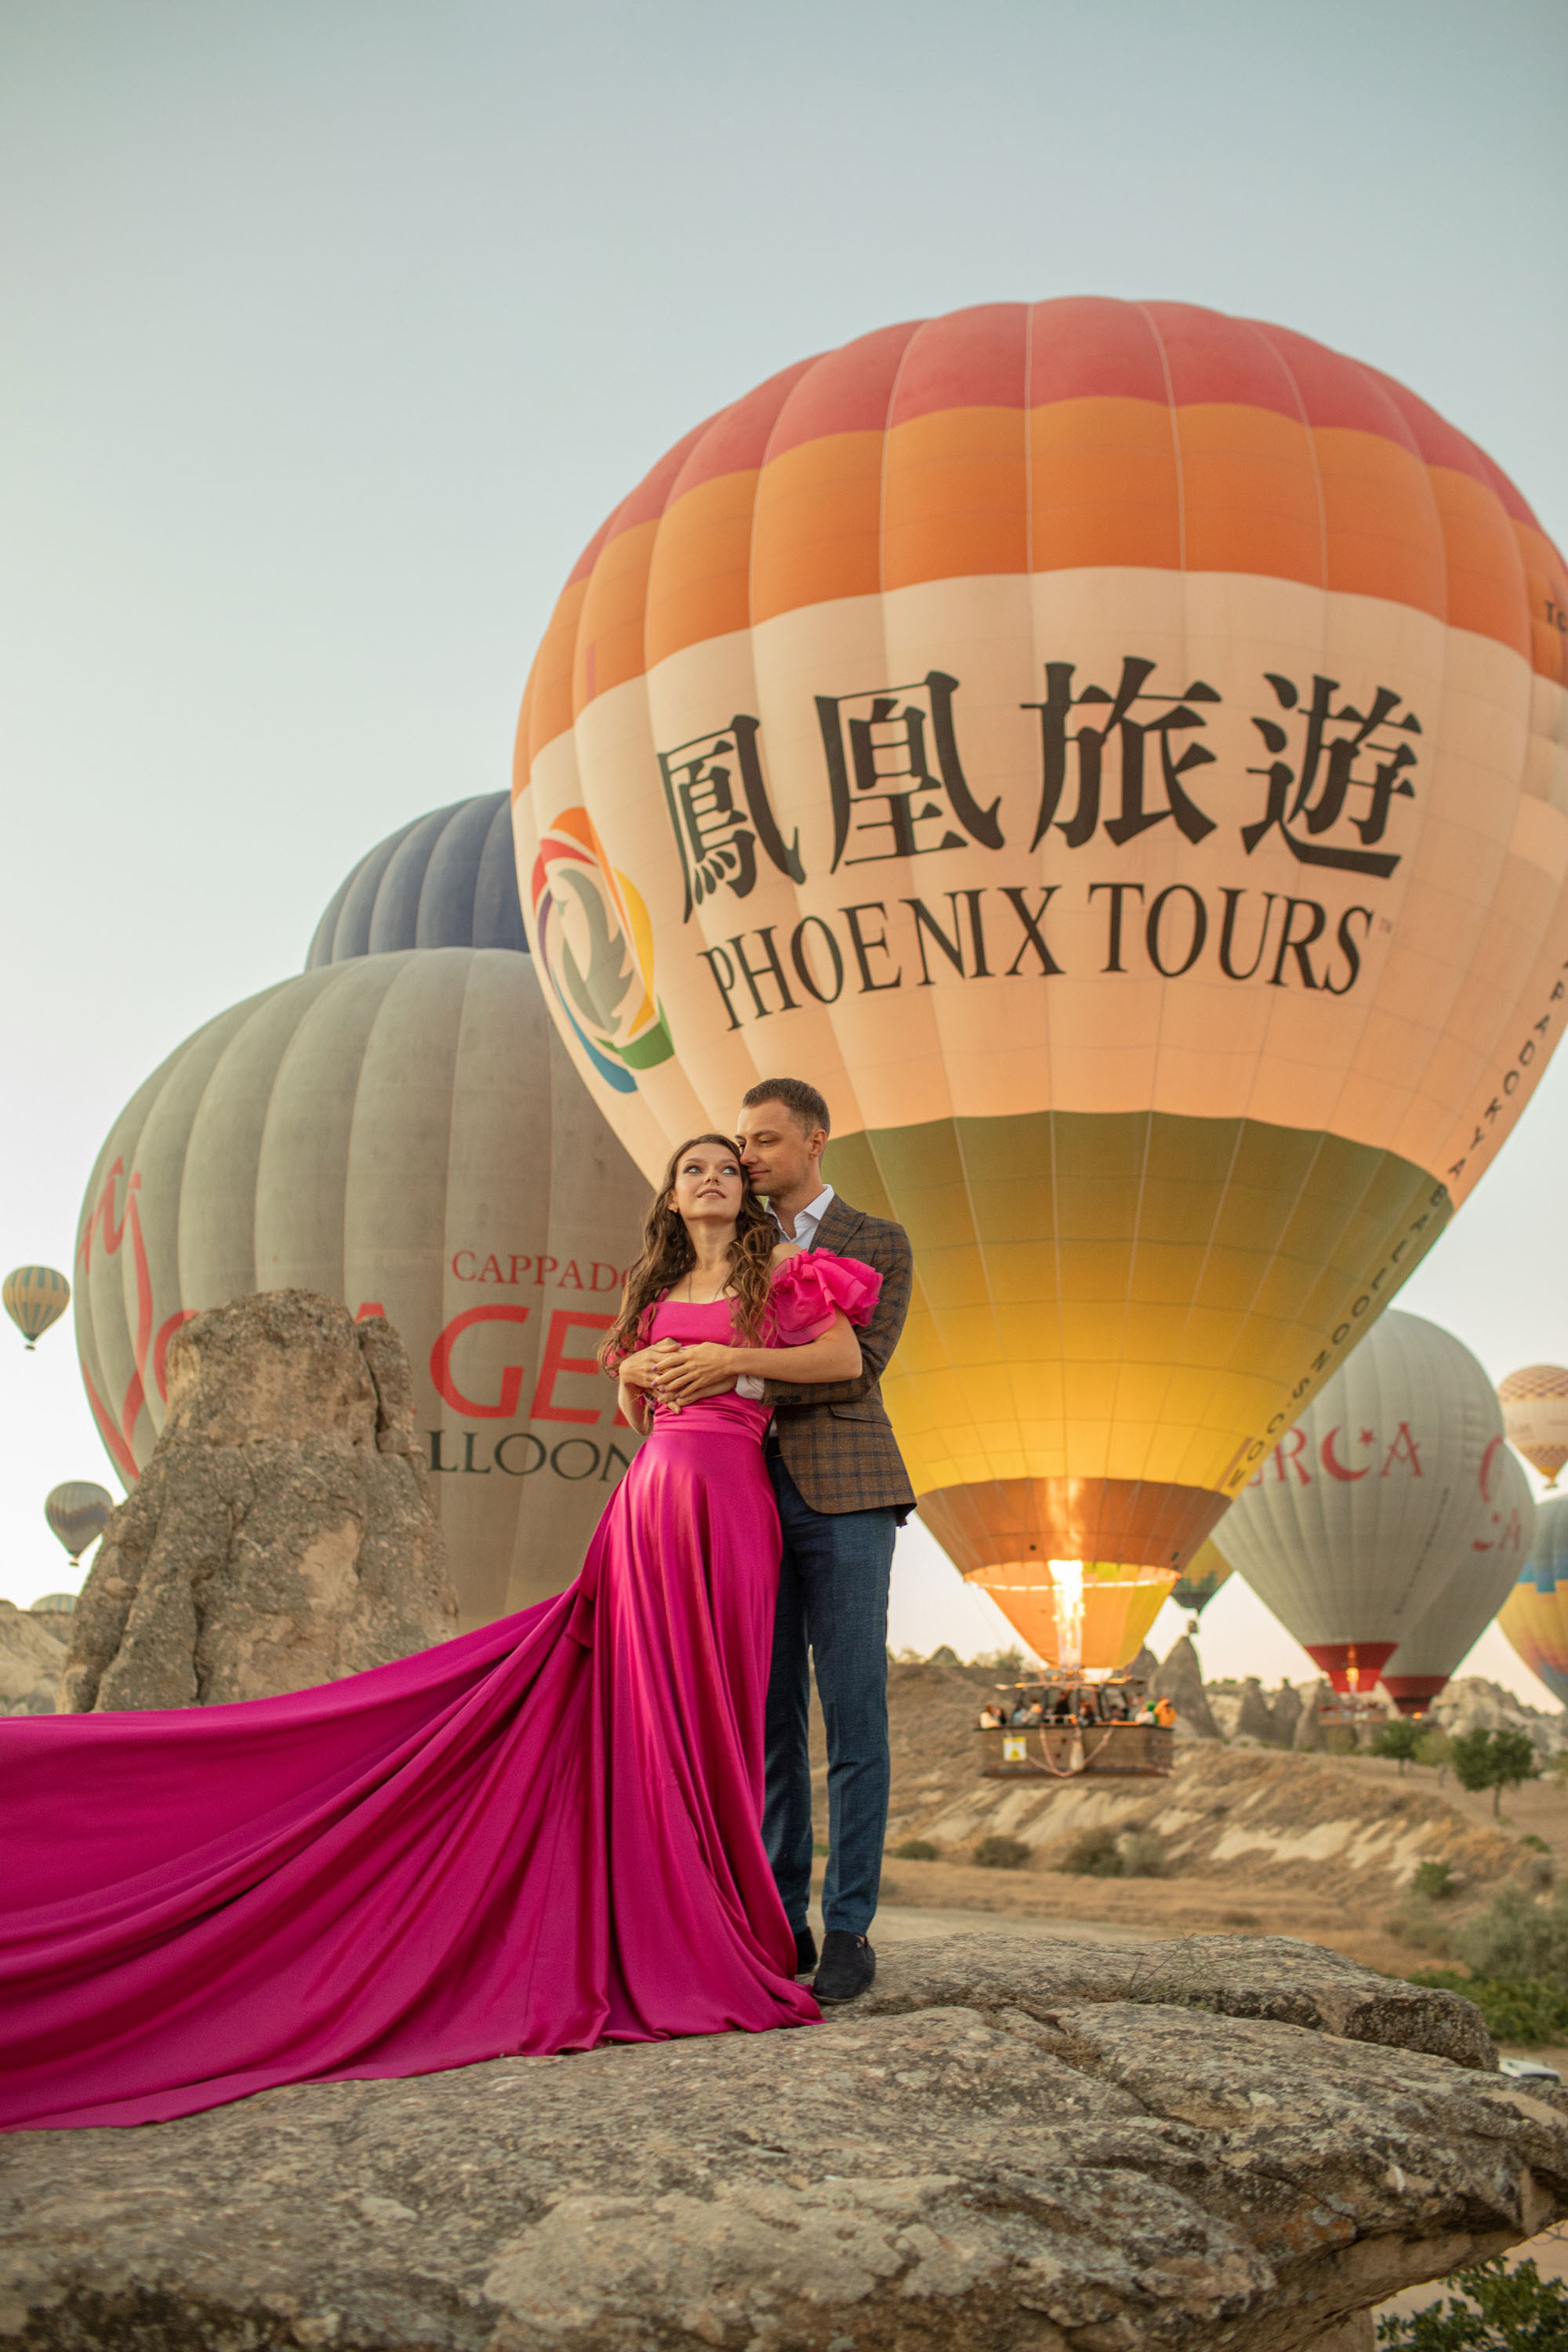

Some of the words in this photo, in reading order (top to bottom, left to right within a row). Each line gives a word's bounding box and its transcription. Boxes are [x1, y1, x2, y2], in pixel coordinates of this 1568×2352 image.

[656, 655, 1423, 924] 鳳凰旅遊
[697, 884, 1066, 1033] PHOENIX
[1087, 883, 1375, 996] TOURS
[1228, 958, 1568, 1488] PADOKYABALLOONS.COM
